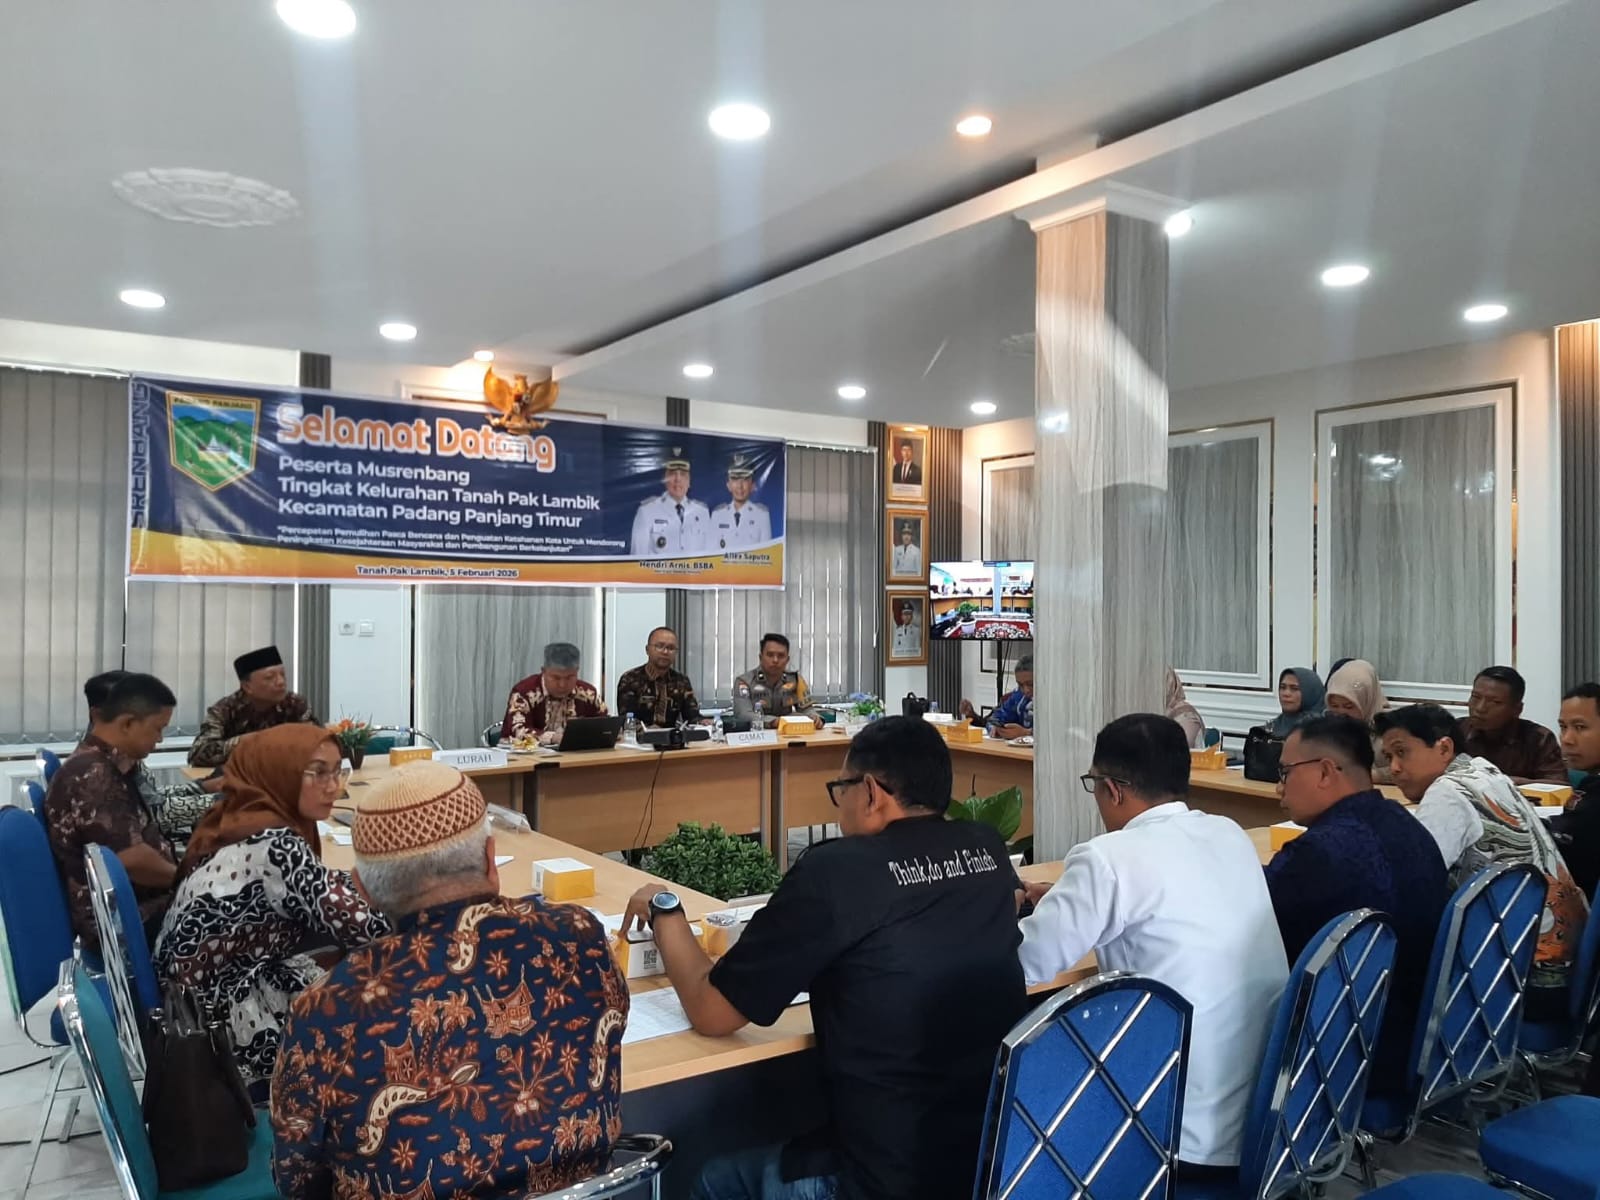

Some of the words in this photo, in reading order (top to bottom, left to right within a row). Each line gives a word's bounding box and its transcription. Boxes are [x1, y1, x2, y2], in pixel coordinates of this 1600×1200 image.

[277, 402, 431, 454] Selamat
[436, 417, 556, 473] Datang
[279, 455, 353, 475] Peserta
[357, 461, 470, 485] Musrenbang
[278, 476, 353, 498] Tingkat
[357, 481, 449, 502] Kelurahan
[452, 487, 504, 505] Tanah
[508, 491, 539, 507] Pak
[542, 494, 600, 510] Lambik
[278, 498, 388, 519] Kecamatan
[392, 504, 461, 525] Padang
[465, 508, 533, 527] Panjang
[536, 511, 582, 528] Timur
[444, 532, 460, 541] dan
[461, 533, 503, 543] Penguatan
[445, 541, 460, 549] dan
[640, 561, 668, 569] Hendri
[357, 566, 387, 575] Tanah
[389, 567, 408, 576] Pak
[738, 731, 765, 741] CAMAT
[457, 754, 492, 765] LURAH
[944, 850, 966, 878] and
[962, 848, 998, 873] Finish
